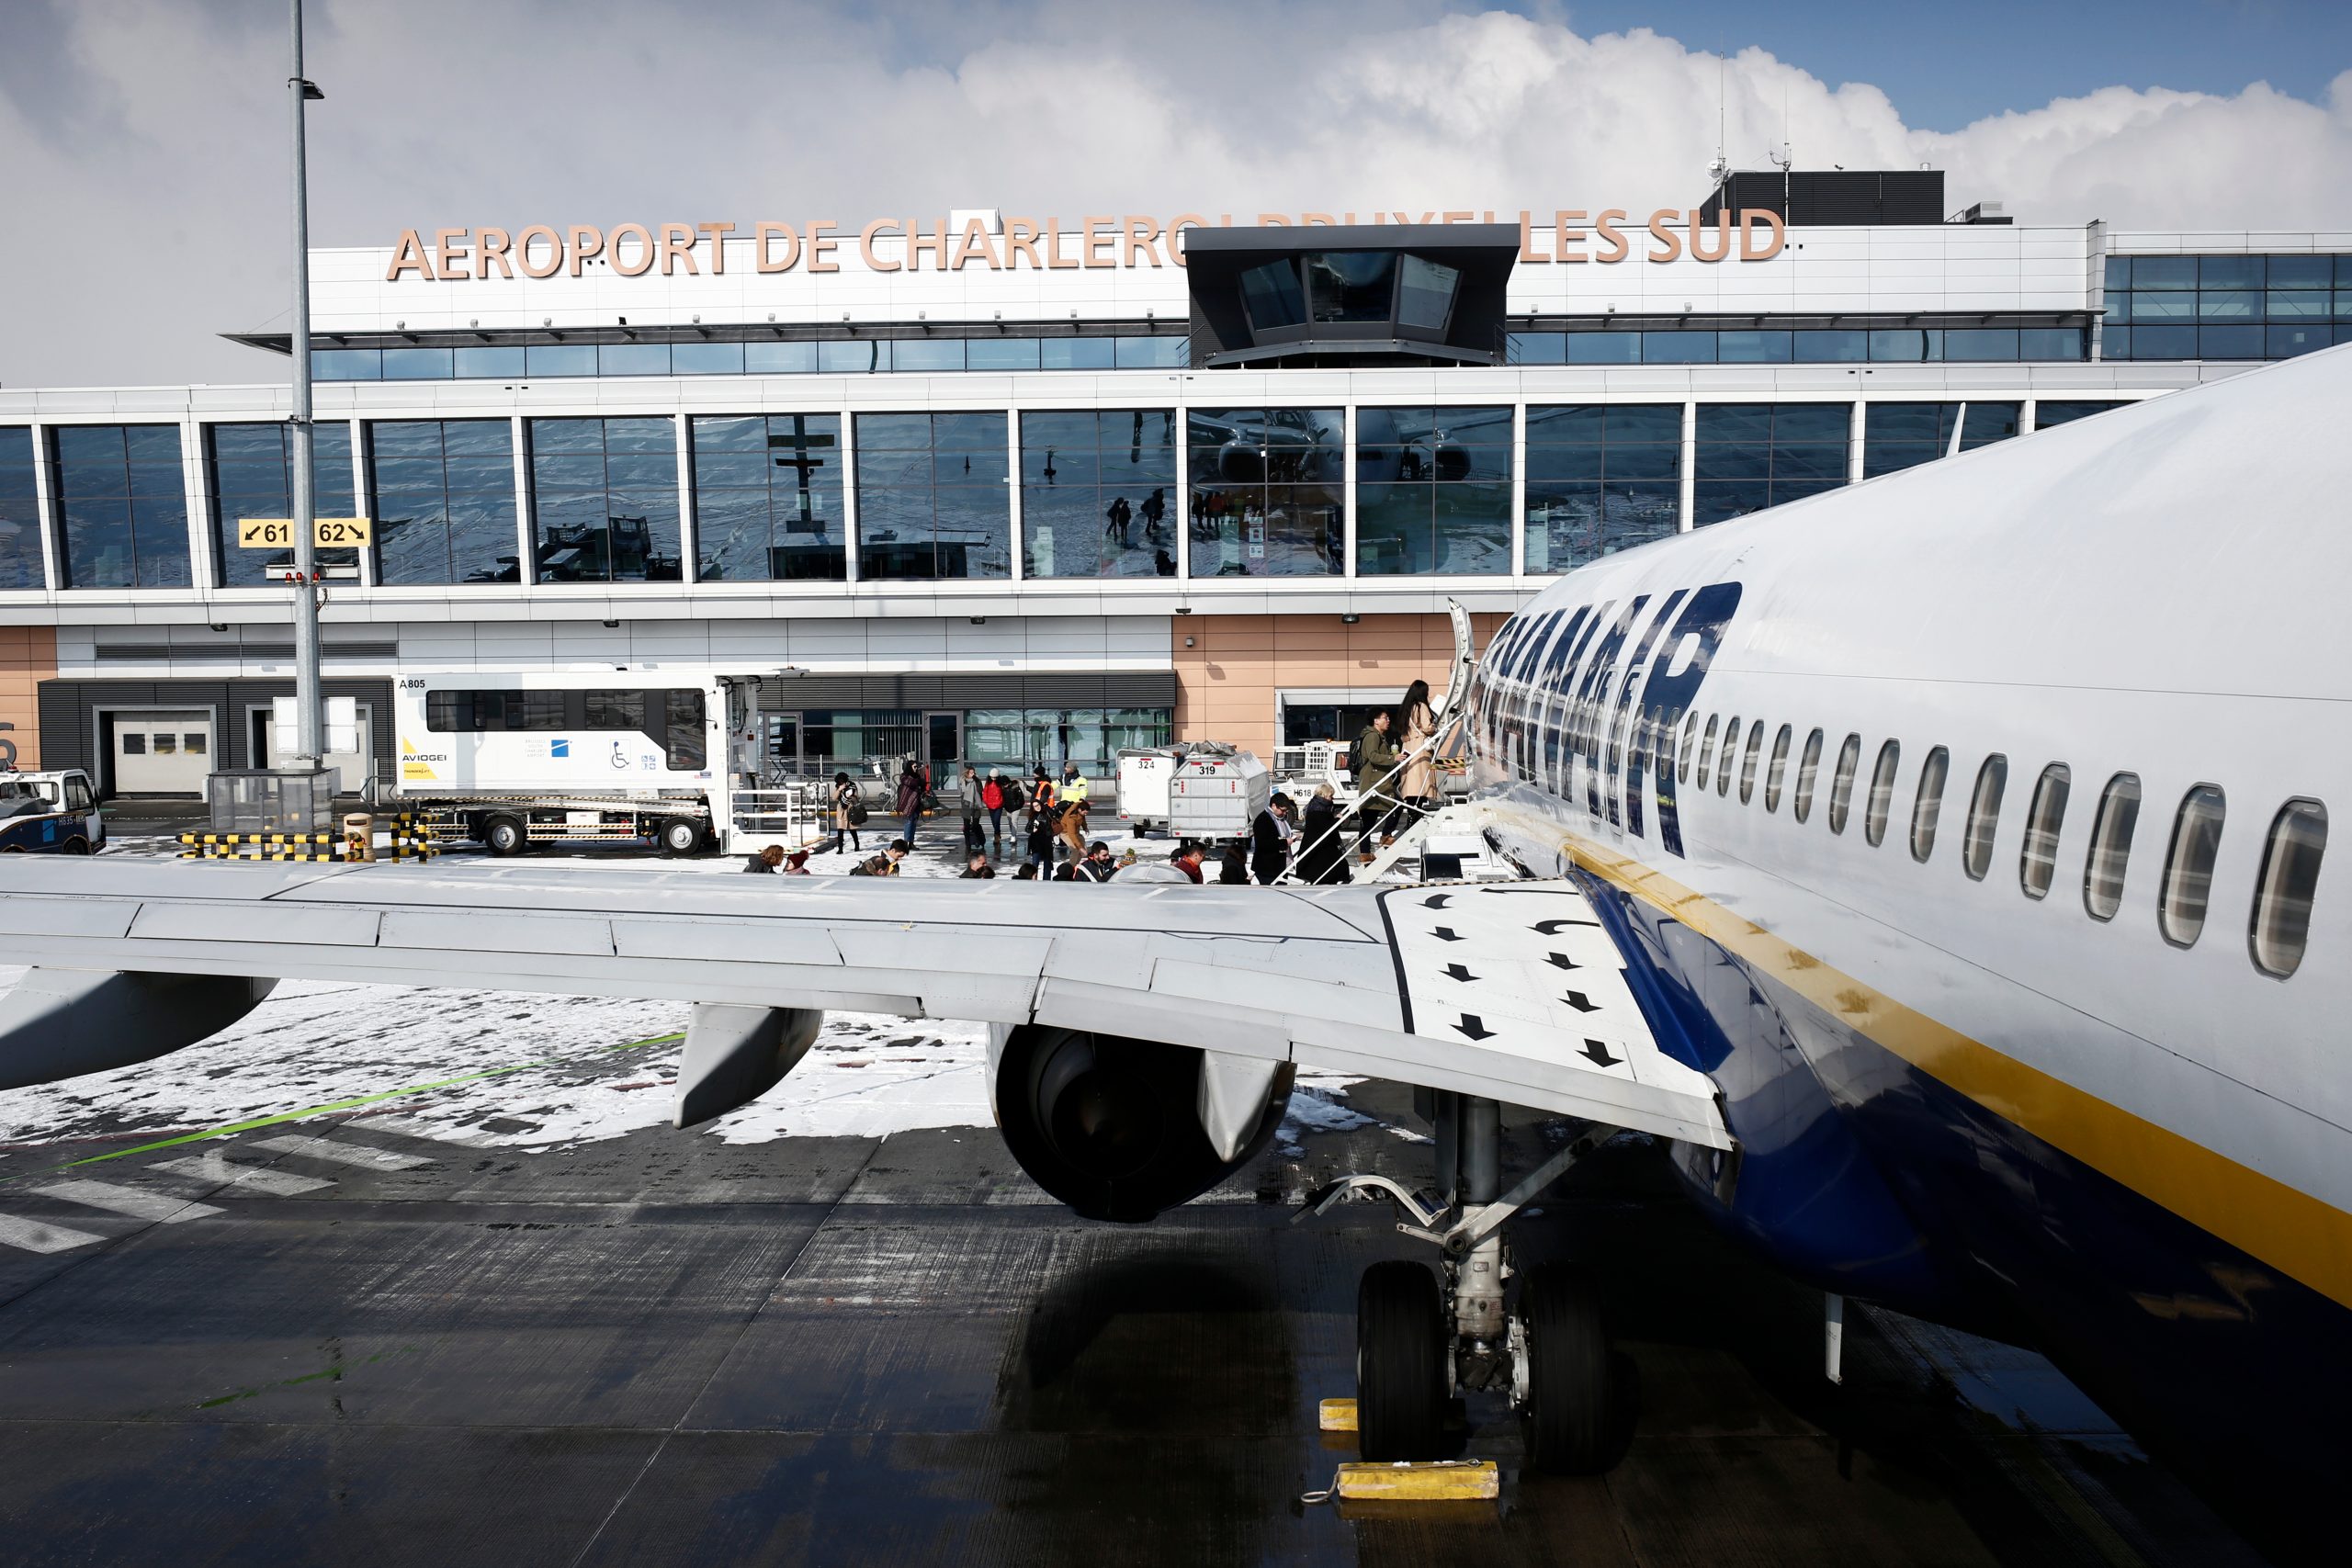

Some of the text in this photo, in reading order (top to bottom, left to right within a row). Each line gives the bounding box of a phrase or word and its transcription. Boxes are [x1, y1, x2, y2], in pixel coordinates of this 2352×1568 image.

[385, 221, 736, 281] AEROPORT
[754, 220, 840, 274] DE
[858, 212, 1232, 272] CHARLERO
[1647, 209, 1787, 262] SUD
[264, 524, 288, 543] 61
[319, 523, 345, 542] 62
[1137, 761, 1155, 770] 324
[1199, 765, 1216, 775] 319
[1294, 789, 1312, 797] H618
